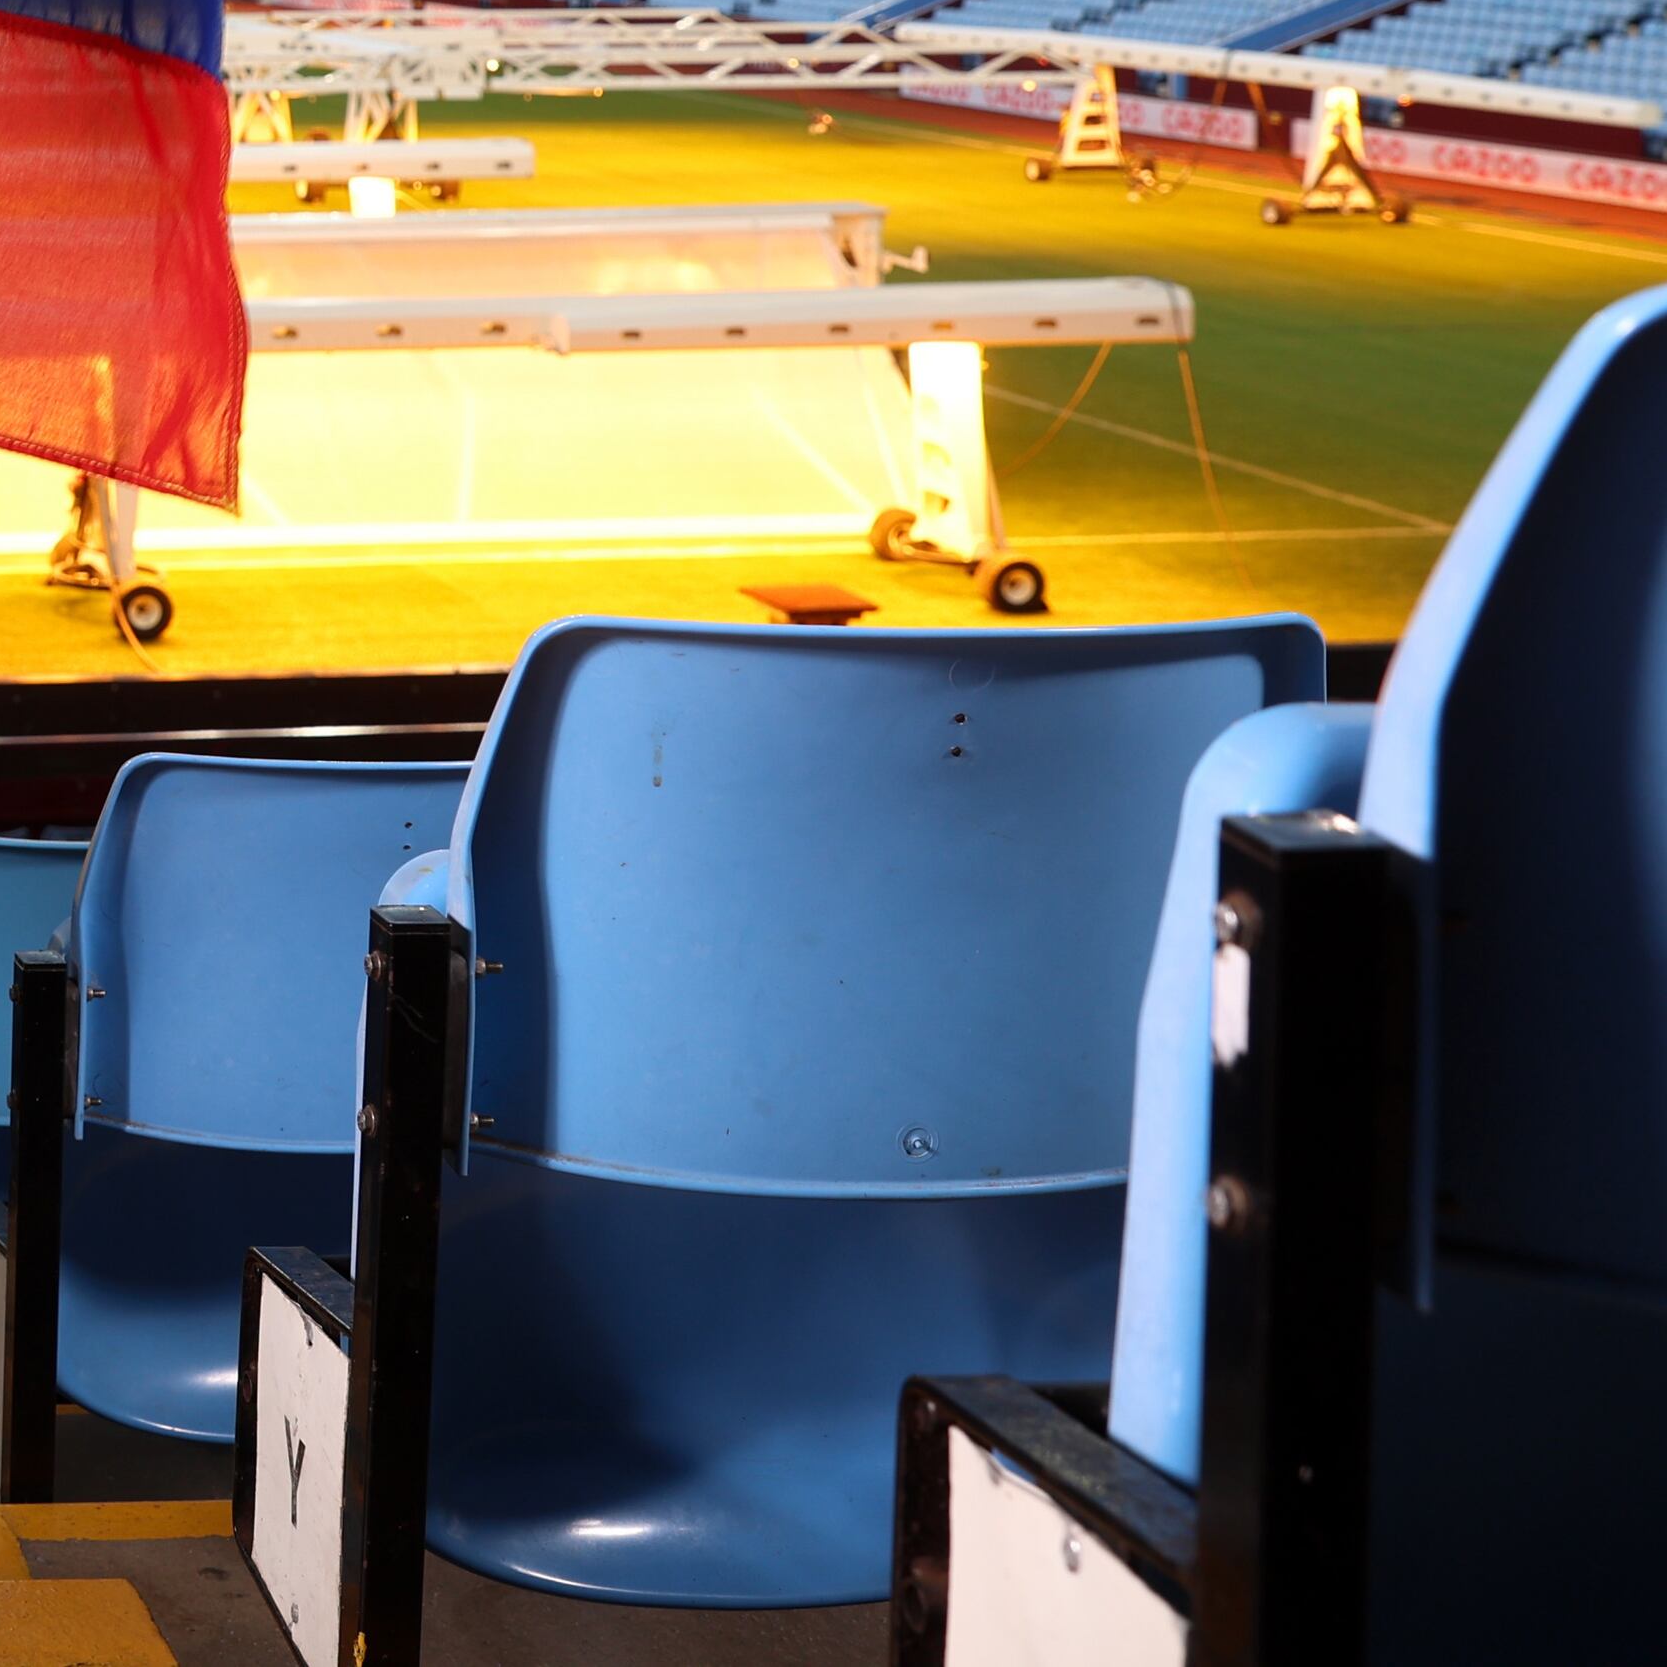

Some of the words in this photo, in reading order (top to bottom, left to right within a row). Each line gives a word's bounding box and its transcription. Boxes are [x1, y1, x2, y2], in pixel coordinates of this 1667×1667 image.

[1162, 105, 1246, 142] CAZOO
[1433, 143, 1541, 183] CAZOO
[1569, 161, 1667, 200] CAZO
[283, 1414, 307, 1530] Y
